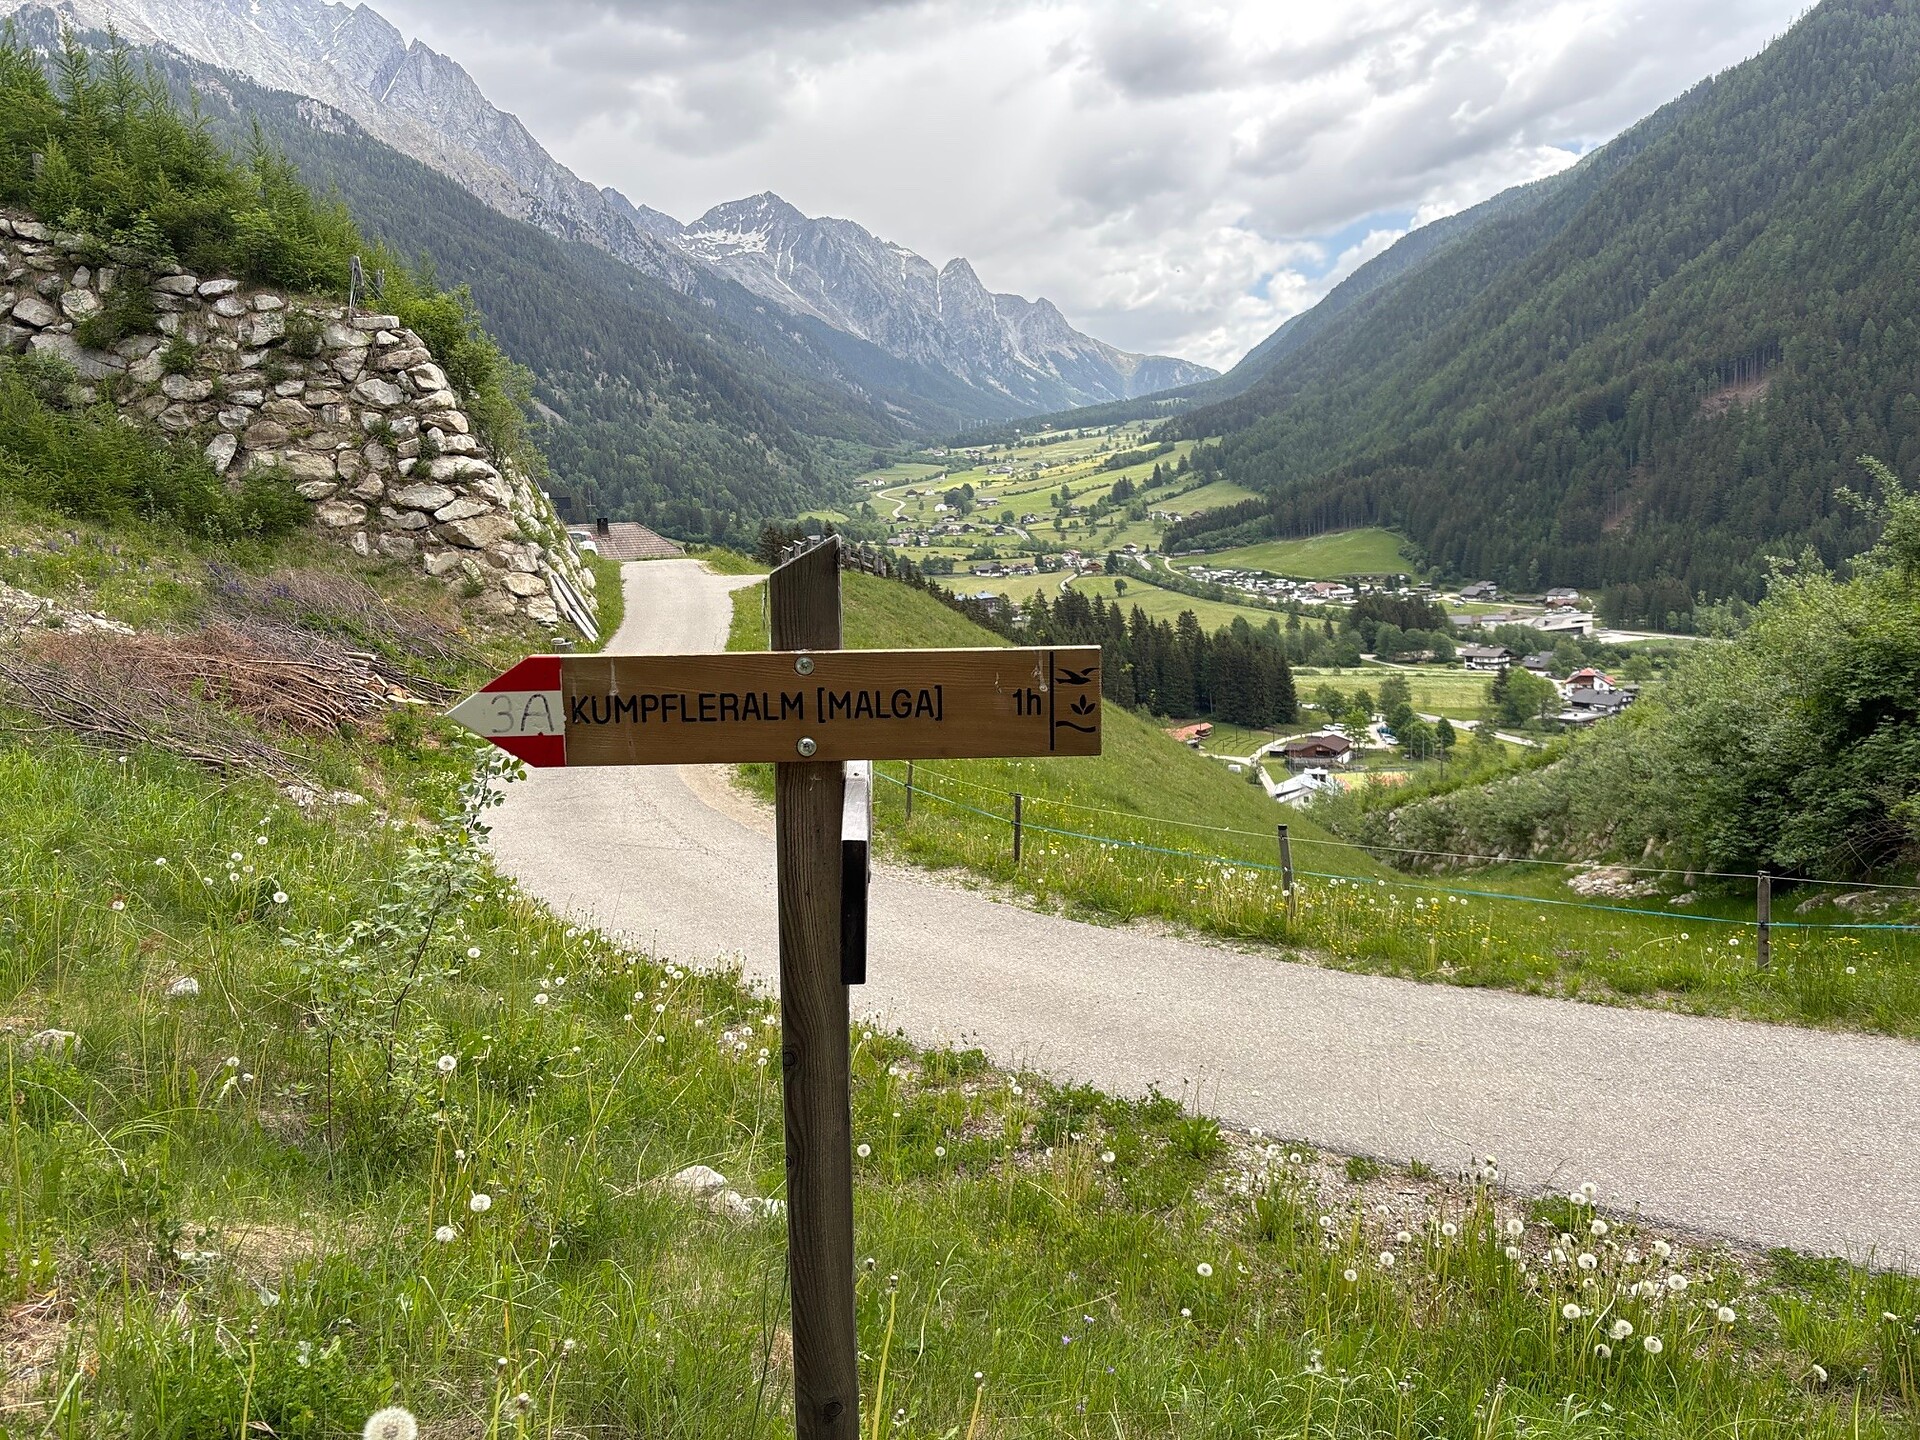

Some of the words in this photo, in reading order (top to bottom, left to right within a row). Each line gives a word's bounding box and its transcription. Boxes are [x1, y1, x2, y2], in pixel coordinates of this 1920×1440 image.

[491, 693, 554, 733] 3A
[571, 691, 804, 725] KUMPFLERALM
[817, 685, 943, 723] [MALGA]
[1012, 688, 1042, 716] 1h
